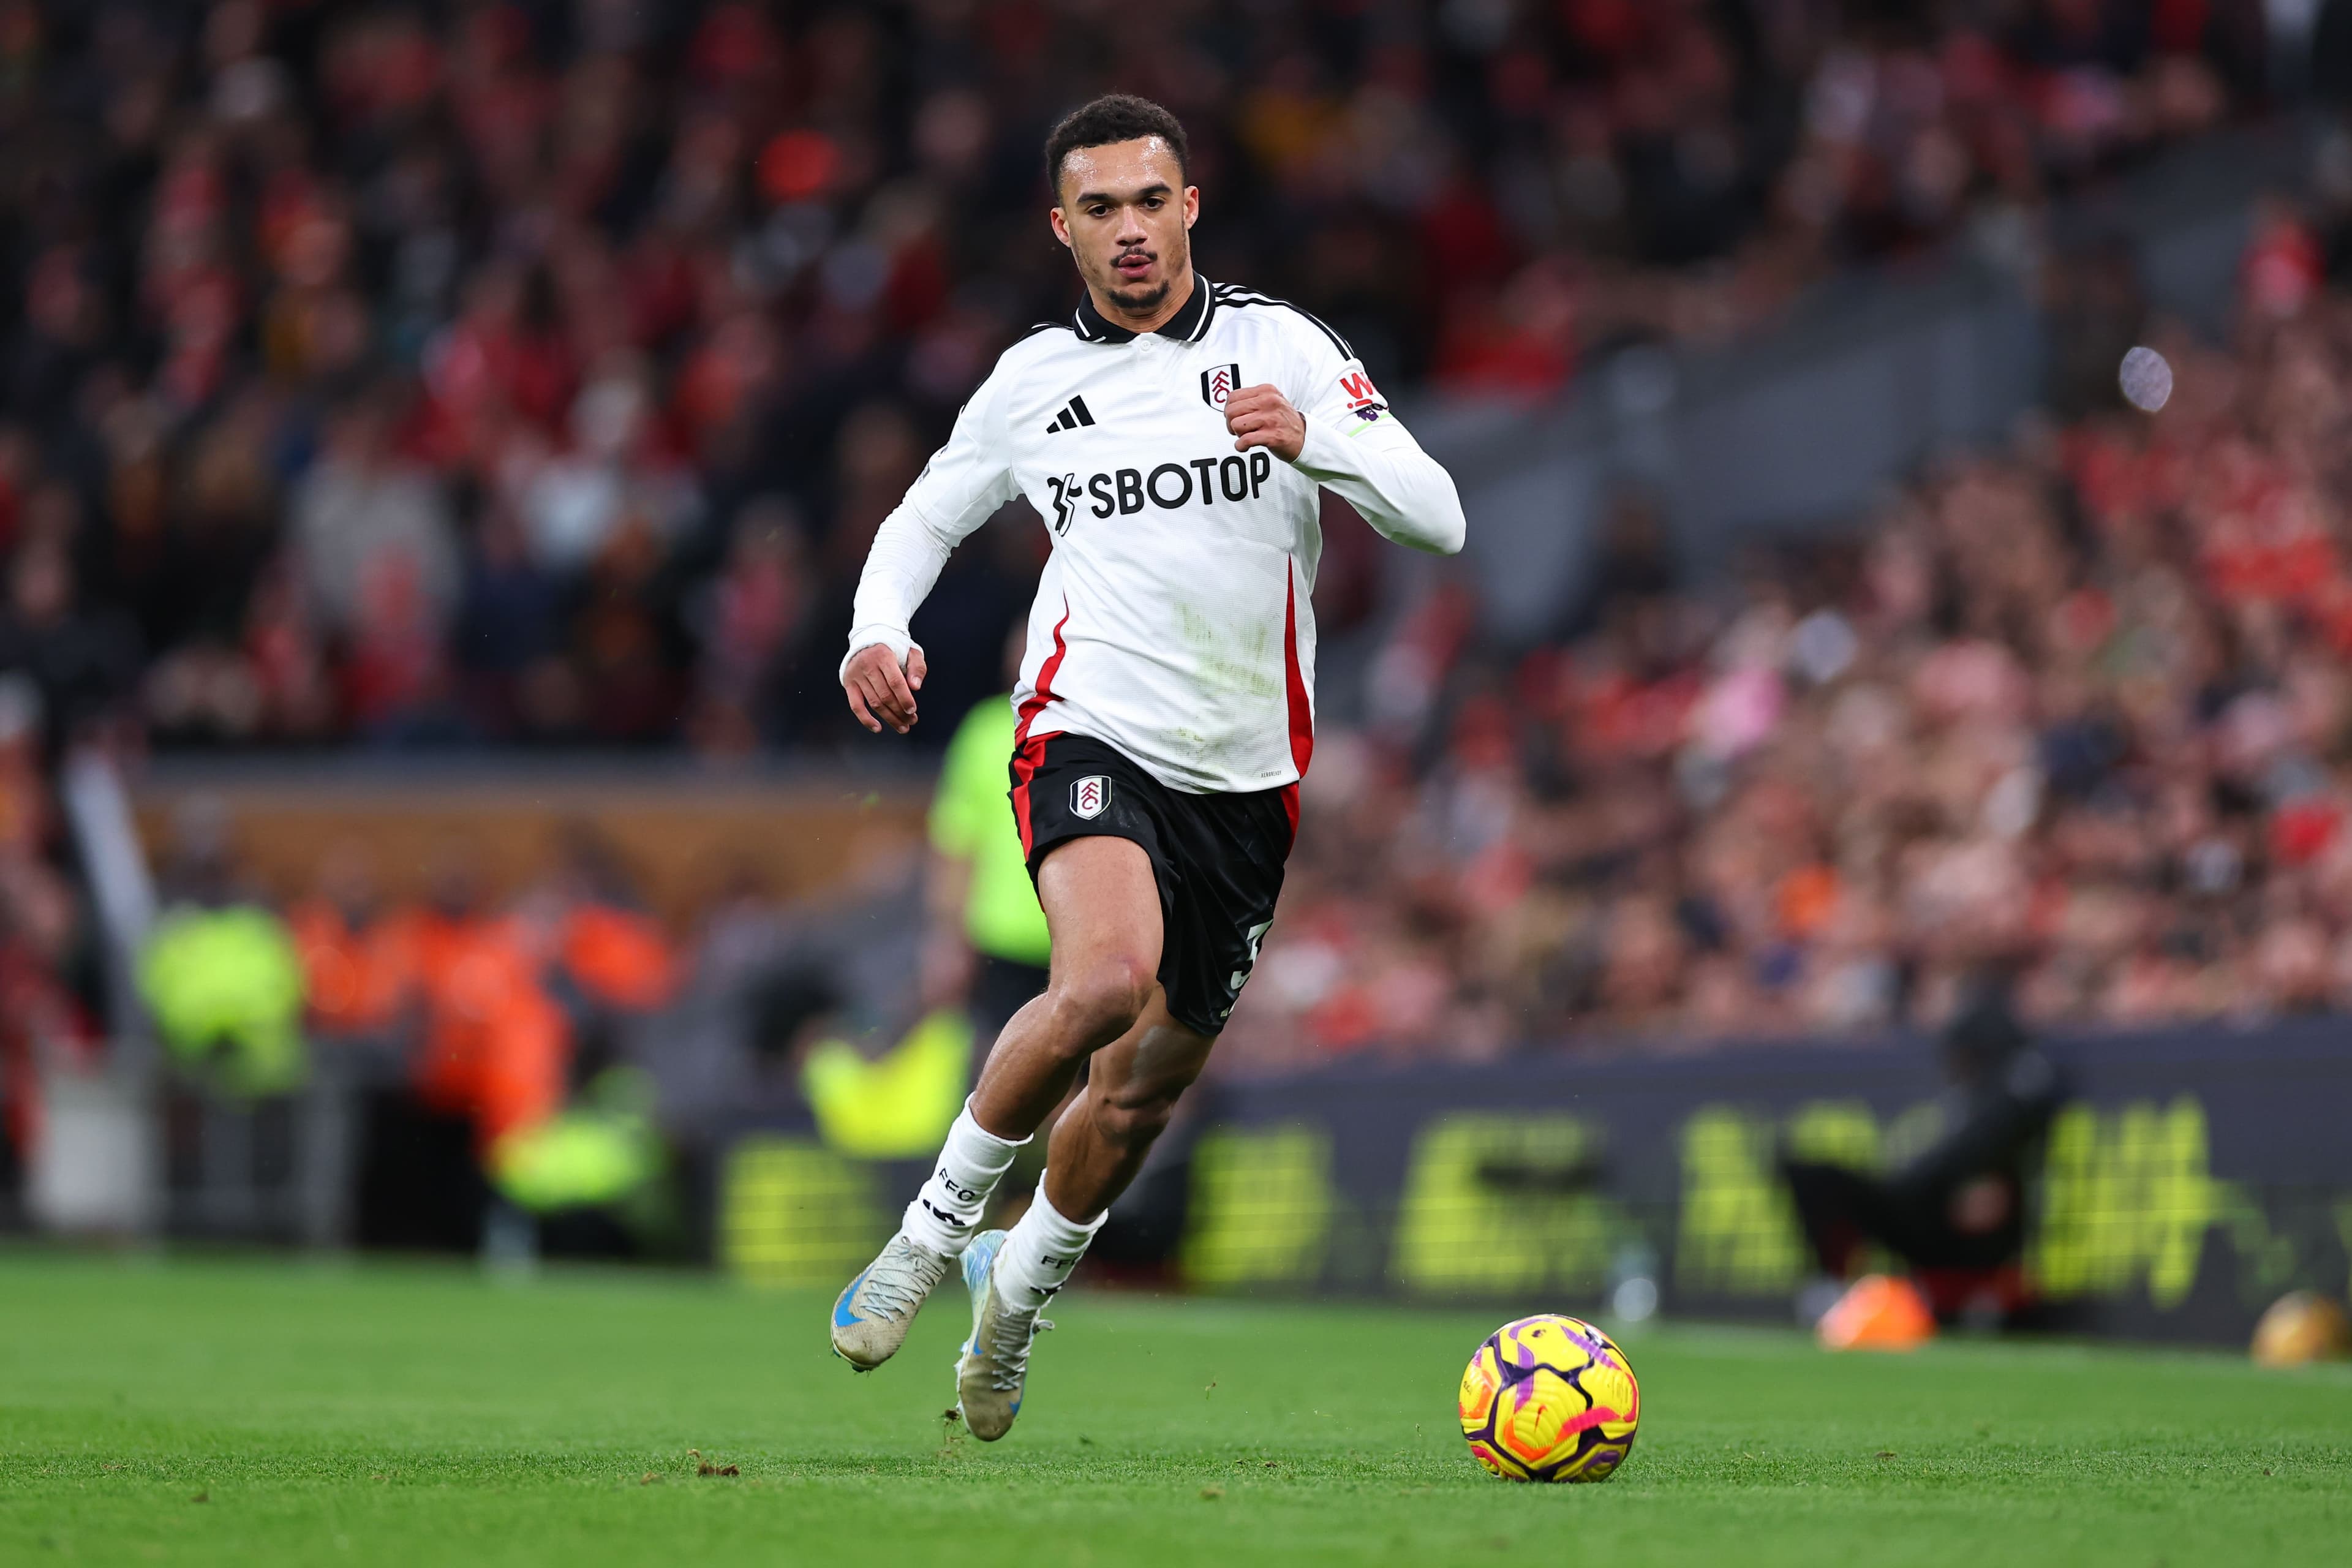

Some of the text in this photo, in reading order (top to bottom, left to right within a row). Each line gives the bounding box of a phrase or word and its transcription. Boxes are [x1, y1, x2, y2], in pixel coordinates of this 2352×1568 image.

[1088, 451, 1270, 519] SBOTOP
[1080, 782, 1099, 810] FFC
[939, 1167, 976, 1201] FFC
